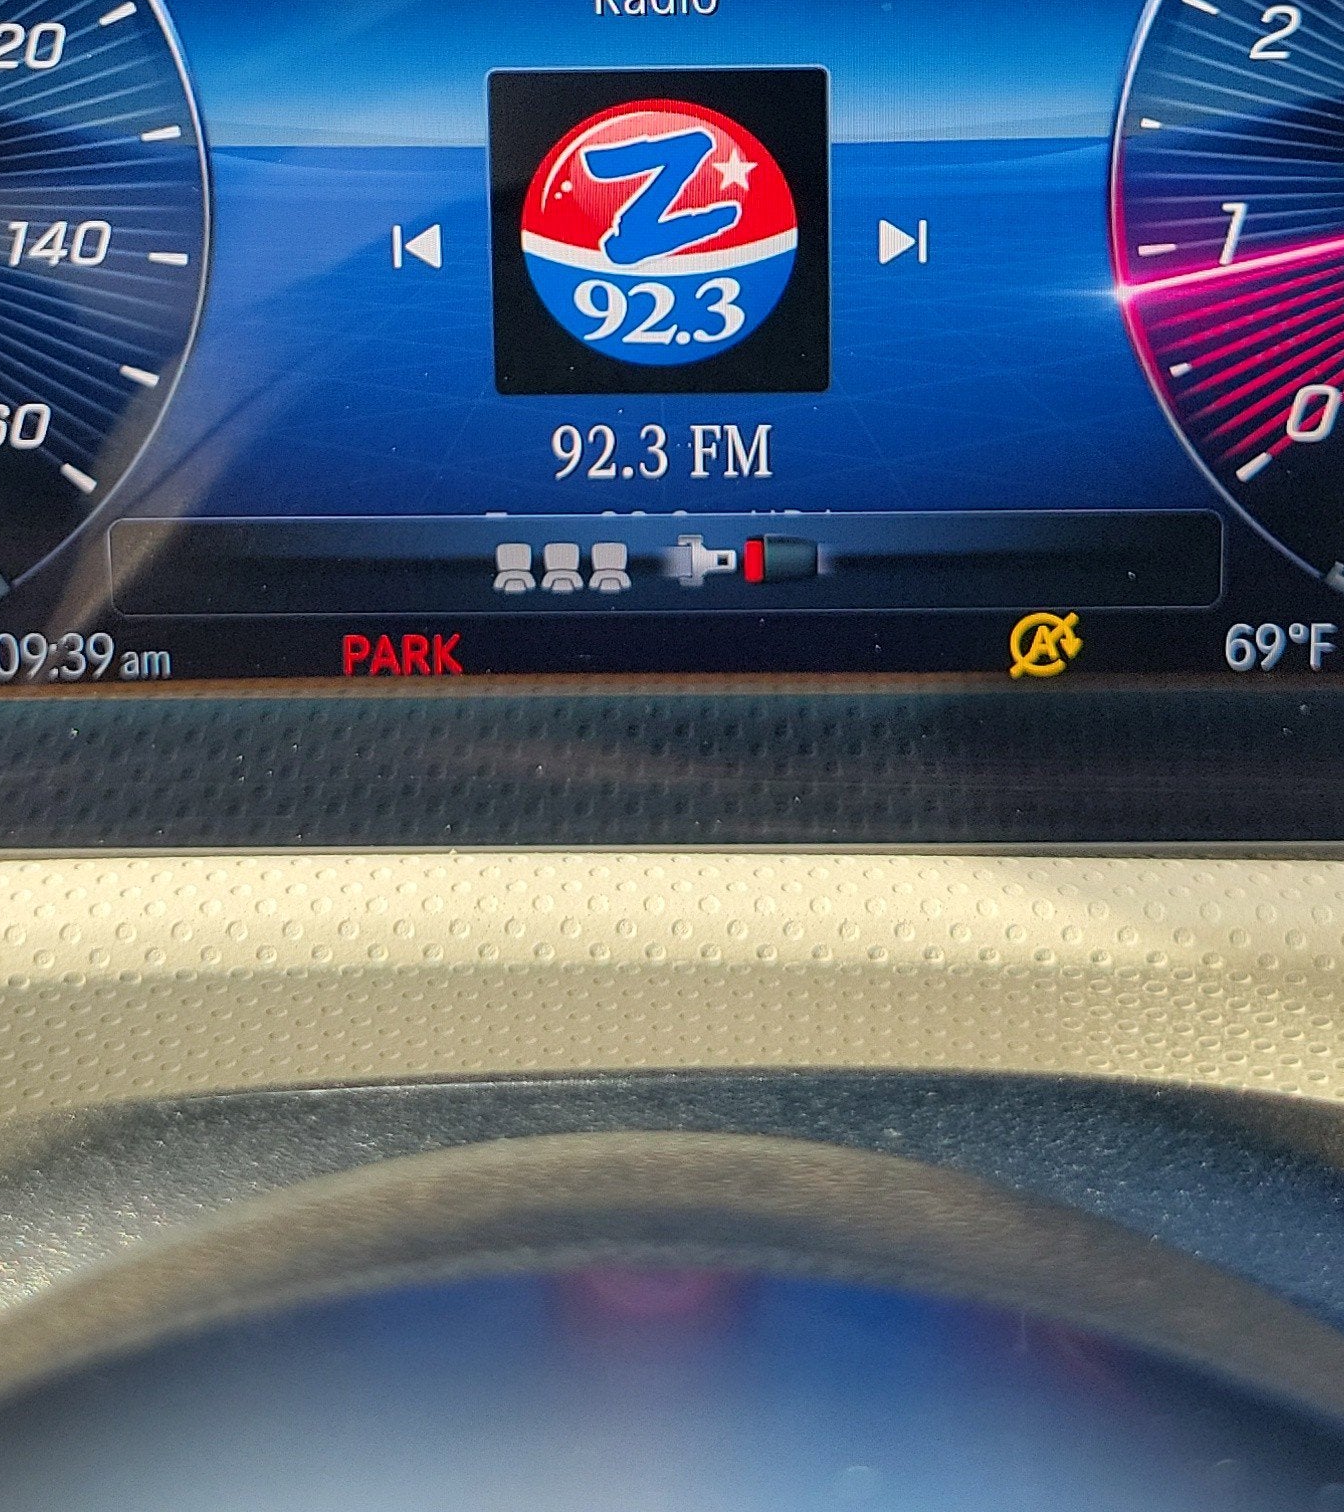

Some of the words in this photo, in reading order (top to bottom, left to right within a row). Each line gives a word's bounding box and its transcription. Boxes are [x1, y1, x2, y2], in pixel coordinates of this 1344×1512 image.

[1248, 5, 1301, 60] 2
[580, 126, 742, 268] Z
[8, 220, 112, 267] 140
[1221, 201, 1248, 266] 1
[573, 277, 745, 345] 92.3
[1286, 383, 1343, 442] 0
[551, 424, 668, 479] 92.3
[689, 424, 773, 478] FM
[120, 650, 171, 676] am
[343, 633, 463, 677] PARK
[1225, 622, 1335, 671] 69°F
